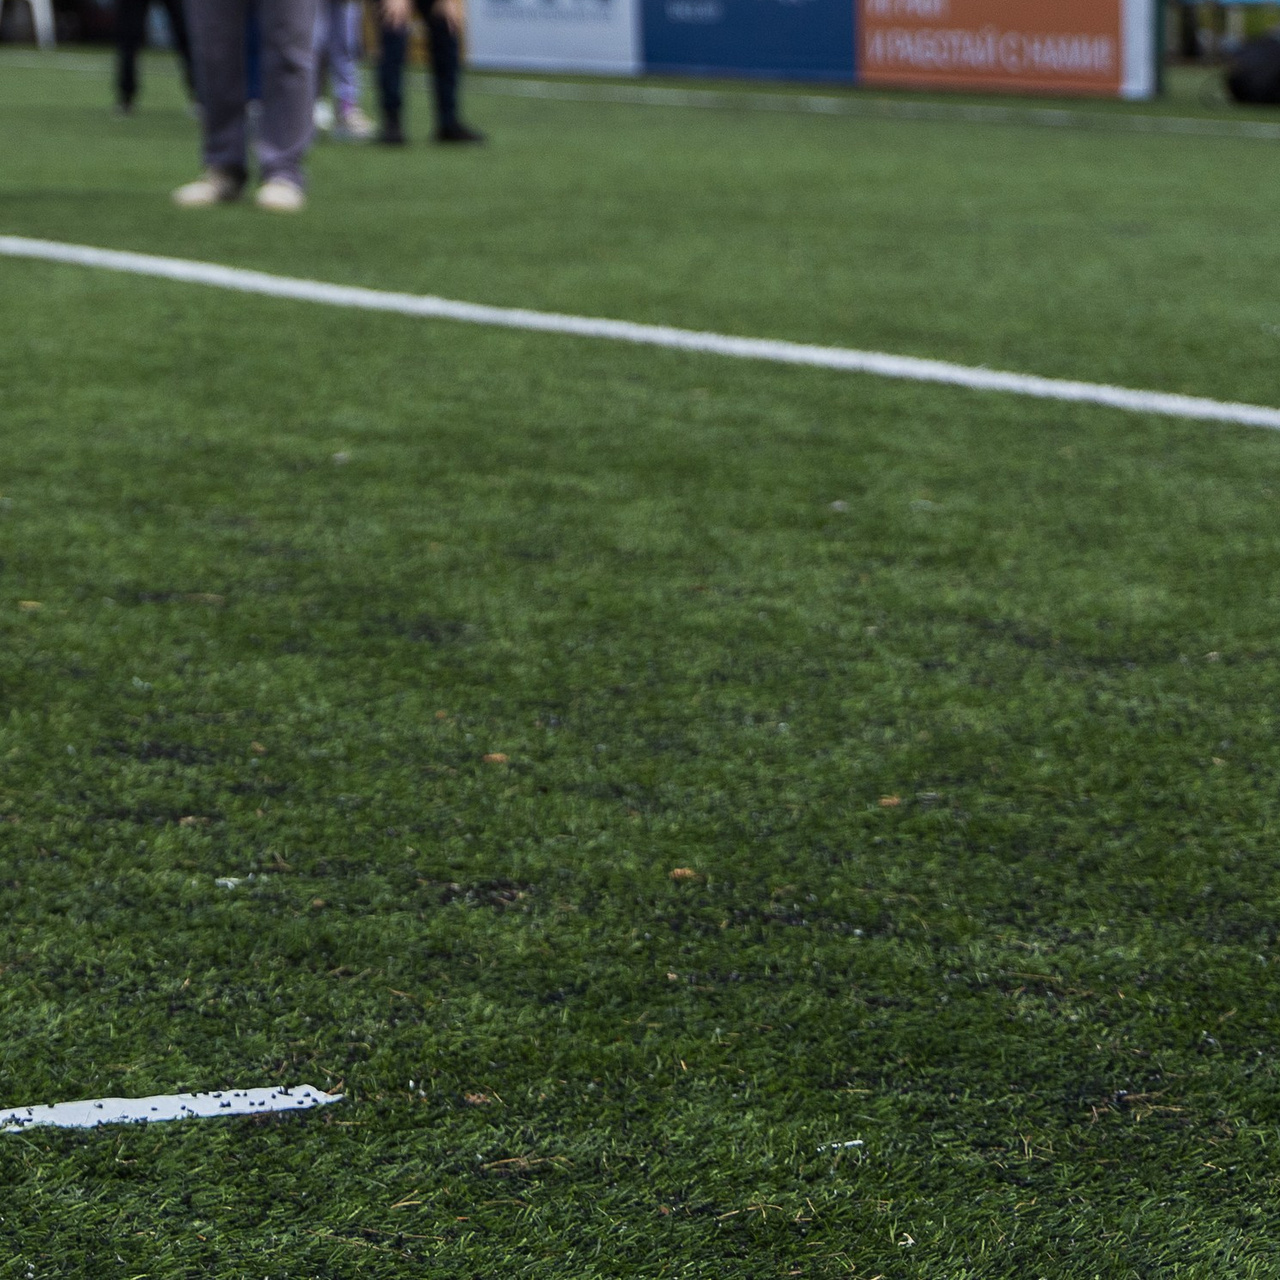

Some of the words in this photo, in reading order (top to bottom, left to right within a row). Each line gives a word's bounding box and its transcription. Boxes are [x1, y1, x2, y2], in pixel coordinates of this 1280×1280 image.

[866, 30, 883, 62] И
[886, 24, 996, 67] РАБОТАЙ
[998, 30, 1024, 72] С
